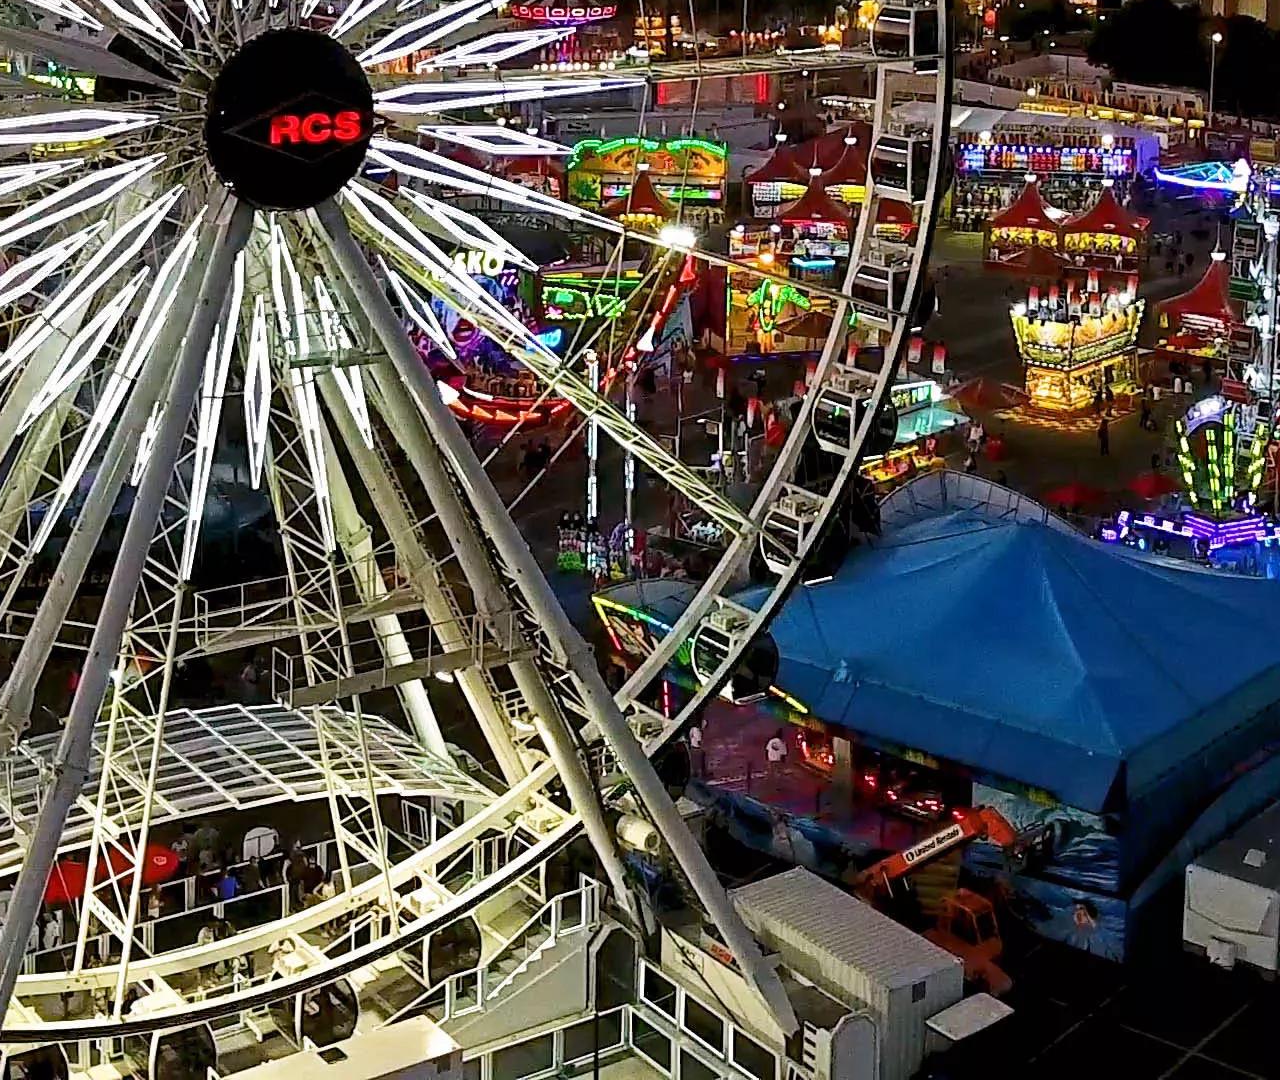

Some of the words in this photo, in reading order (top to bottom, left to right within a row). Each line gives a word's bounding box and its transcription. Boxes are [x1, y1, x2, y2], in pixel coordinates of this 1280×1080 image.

[271, 111, 361, 145] RCS
[914, 841, 936, 857] United
[936, 828, 959, 845] Rentals
